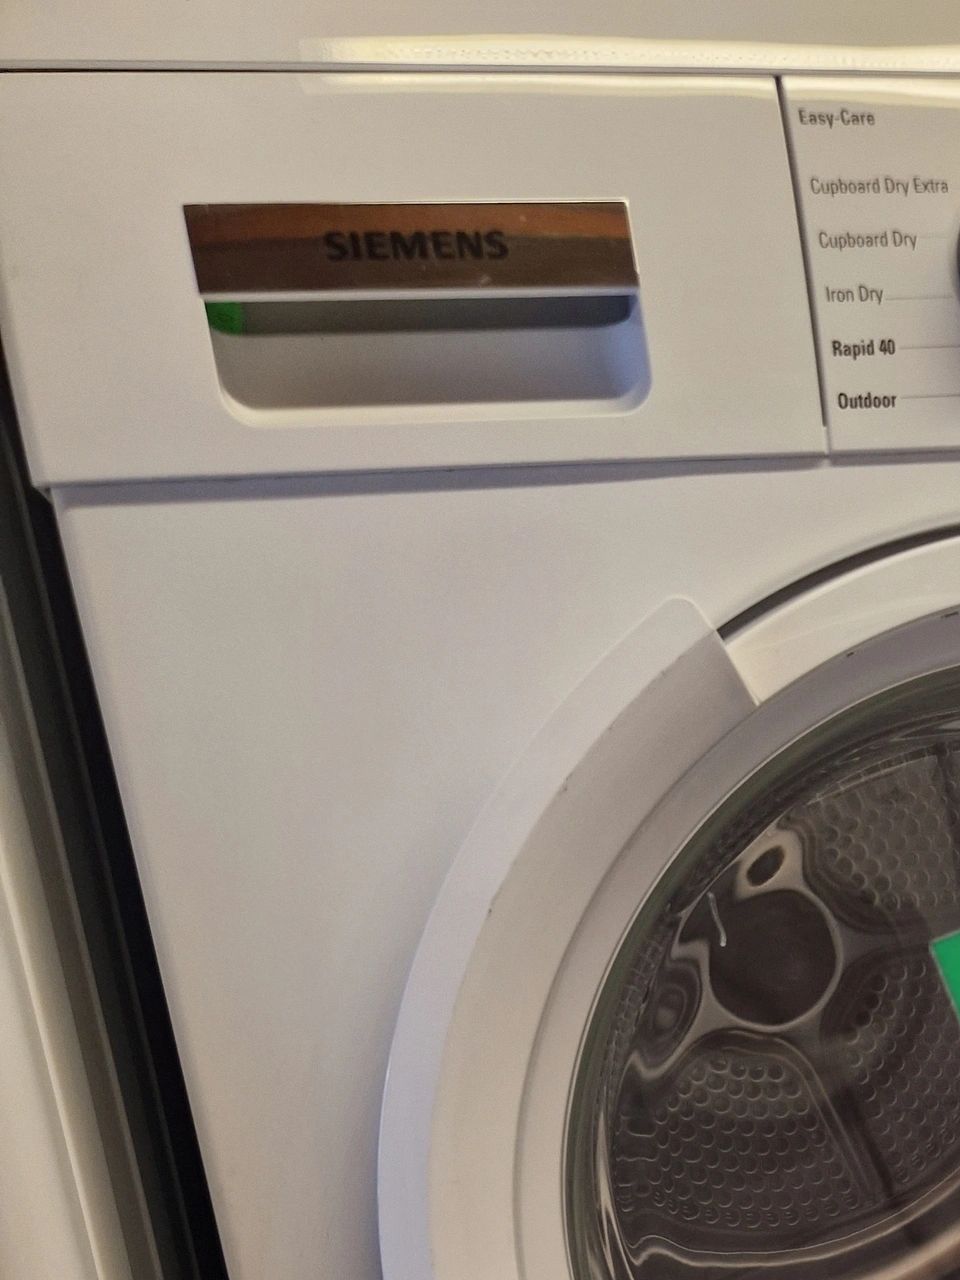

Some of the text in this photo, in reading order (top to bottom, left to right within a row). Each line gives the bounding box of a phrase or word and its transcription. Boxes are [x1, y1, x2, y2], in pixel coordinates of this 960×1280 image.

[798, 109, 876, 127] Easy-Care
[810, 176, 949, 197] Cupboard Dry Extra
[324, 229, 510, 263] SIEMENS
[818, 230, 917, 251] Cupboard Dry
[825, 285, 884, 305] Iron Dry
[831, 339, 896, 360] Rapid 40
[837, 392, 897, 410] Outdoor
